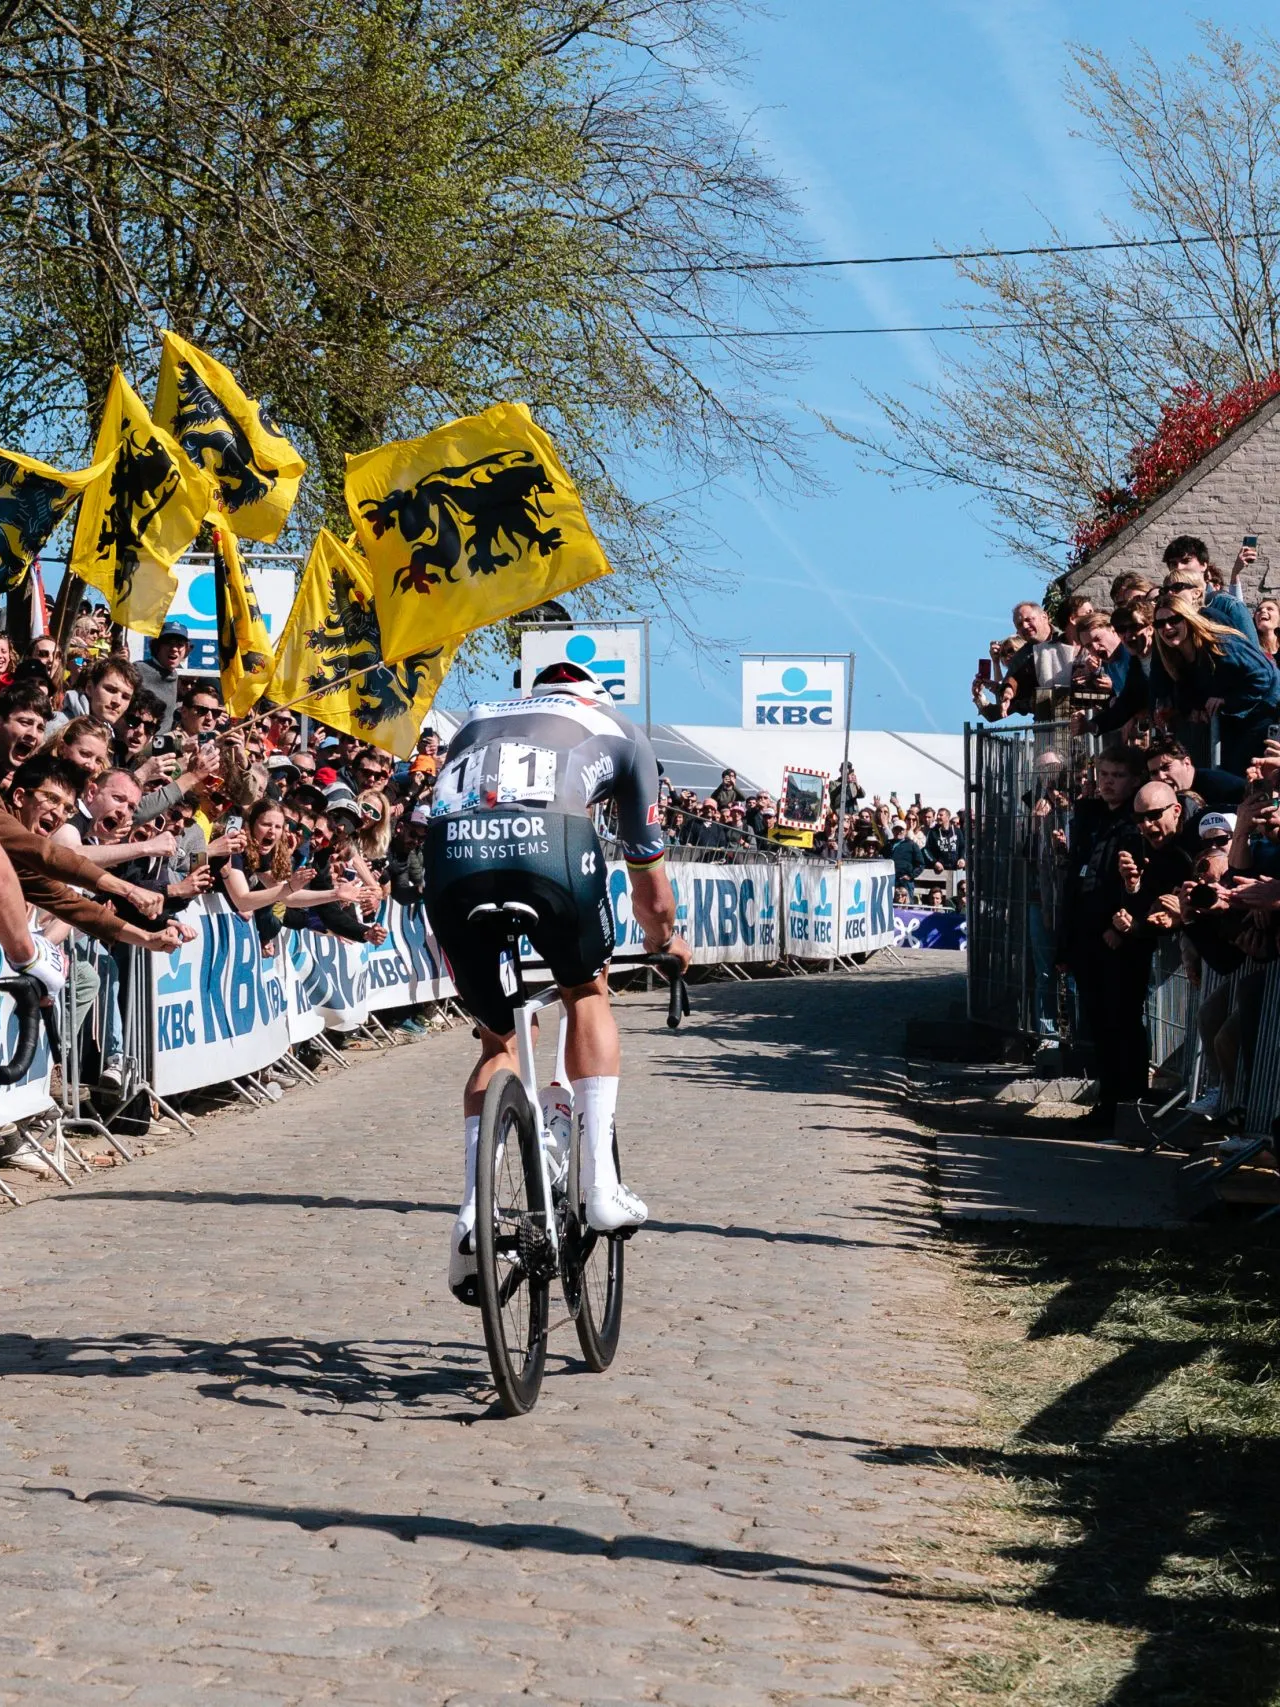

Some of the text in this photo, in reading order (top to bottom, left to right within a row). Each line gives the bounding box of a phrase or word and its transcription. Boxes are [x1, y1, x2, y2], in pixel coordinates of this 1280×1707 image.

[756, 706, 833, 726] KBC
[451, 757, 470, 794] 1
[519, 752, 536, 787] 1
[446, 817, 546, 841] BRUSTOR
[446, 841, 549, 859] SUN SYSTEMS
[694, 878, 755, 947] KBC
[760, 923, 775, 946] KBC
[790, 916, 809, 940] KBC
[814, 921, 831, 943] KBC
[845, 916, 866, 940] KBC
[370, 954, 410, 989] KBC
[157, 999, 196, 1052] KBC
